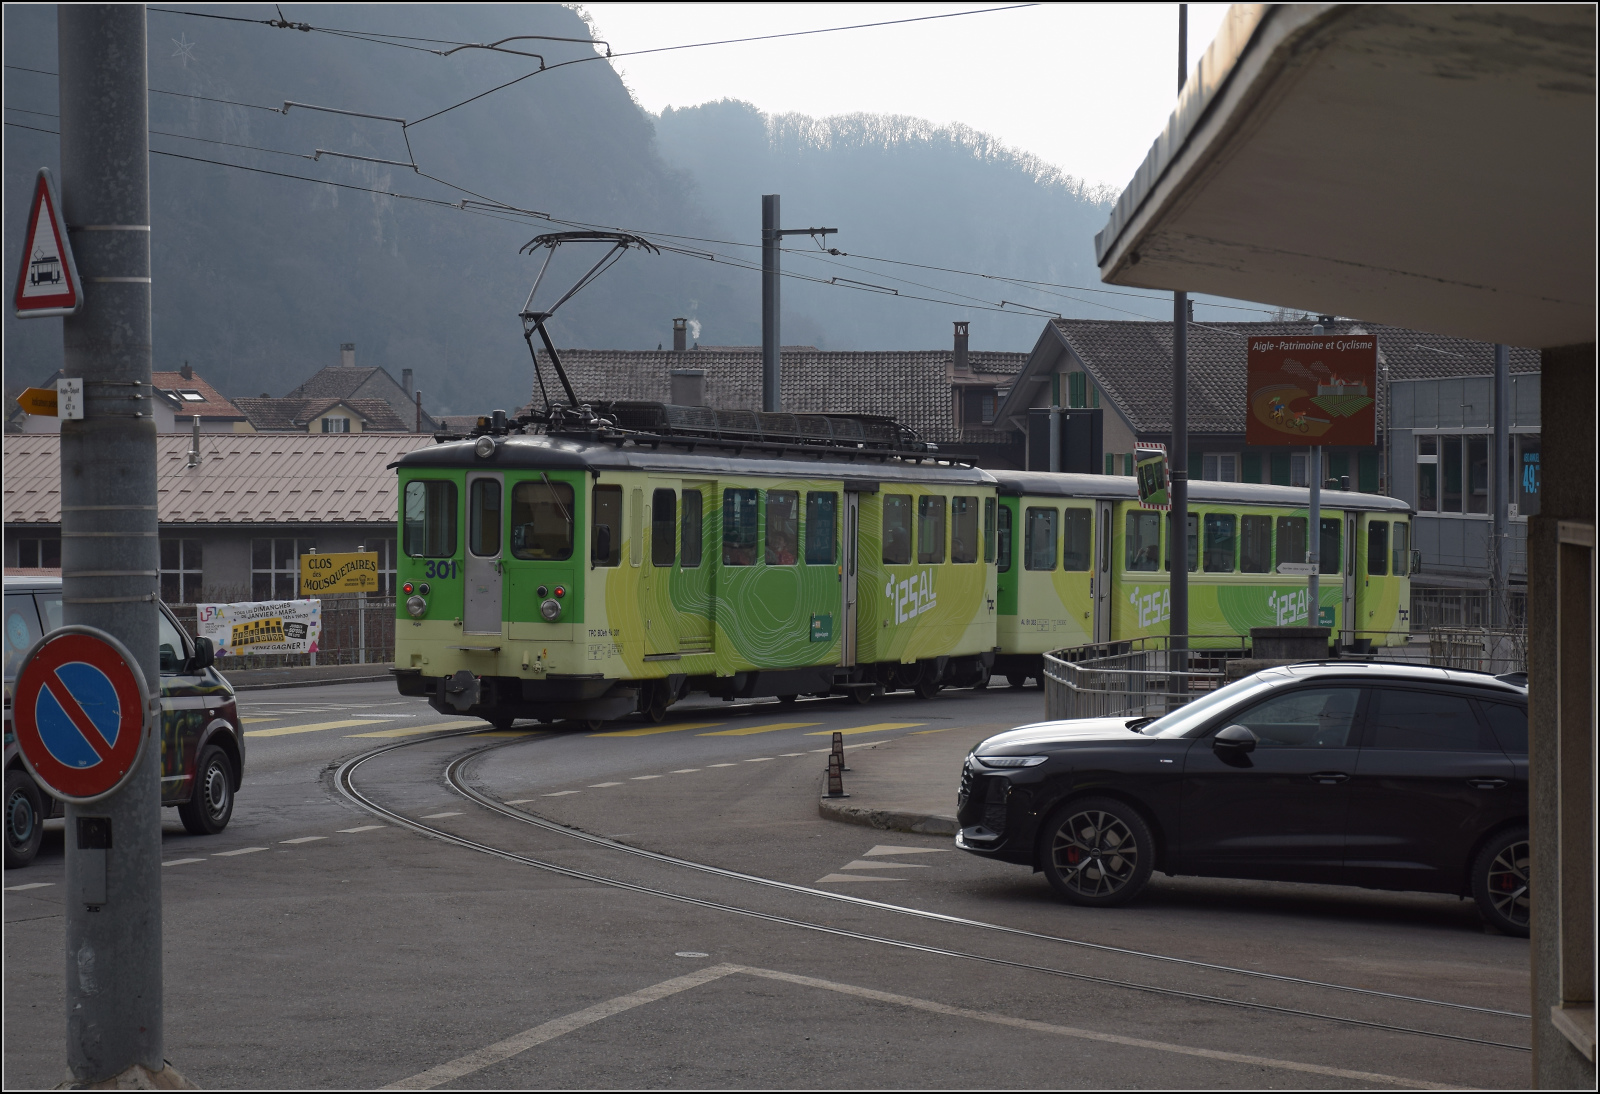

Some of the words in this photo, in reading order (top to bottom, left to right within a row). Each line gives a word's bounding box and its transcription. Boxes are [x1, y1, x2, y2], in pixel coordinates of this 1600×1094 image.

[1325, 342, 1334, 350] et
[1336, 340, 1373, 351] Cyclisme
[308, 558, 332, 570] CLOS
[425, 560, 456, 580] 301
[303, 559, 376, 591] MOUSQUETAIRES
[254, 602, 291, 612] DIMANCHES
[1138, 588, 1171, 629] 125A
[247, 611, 274, 620] JANVIER
[278, 608, 297, 616] MARS
[271, 642, 301, 650] GAGNER
